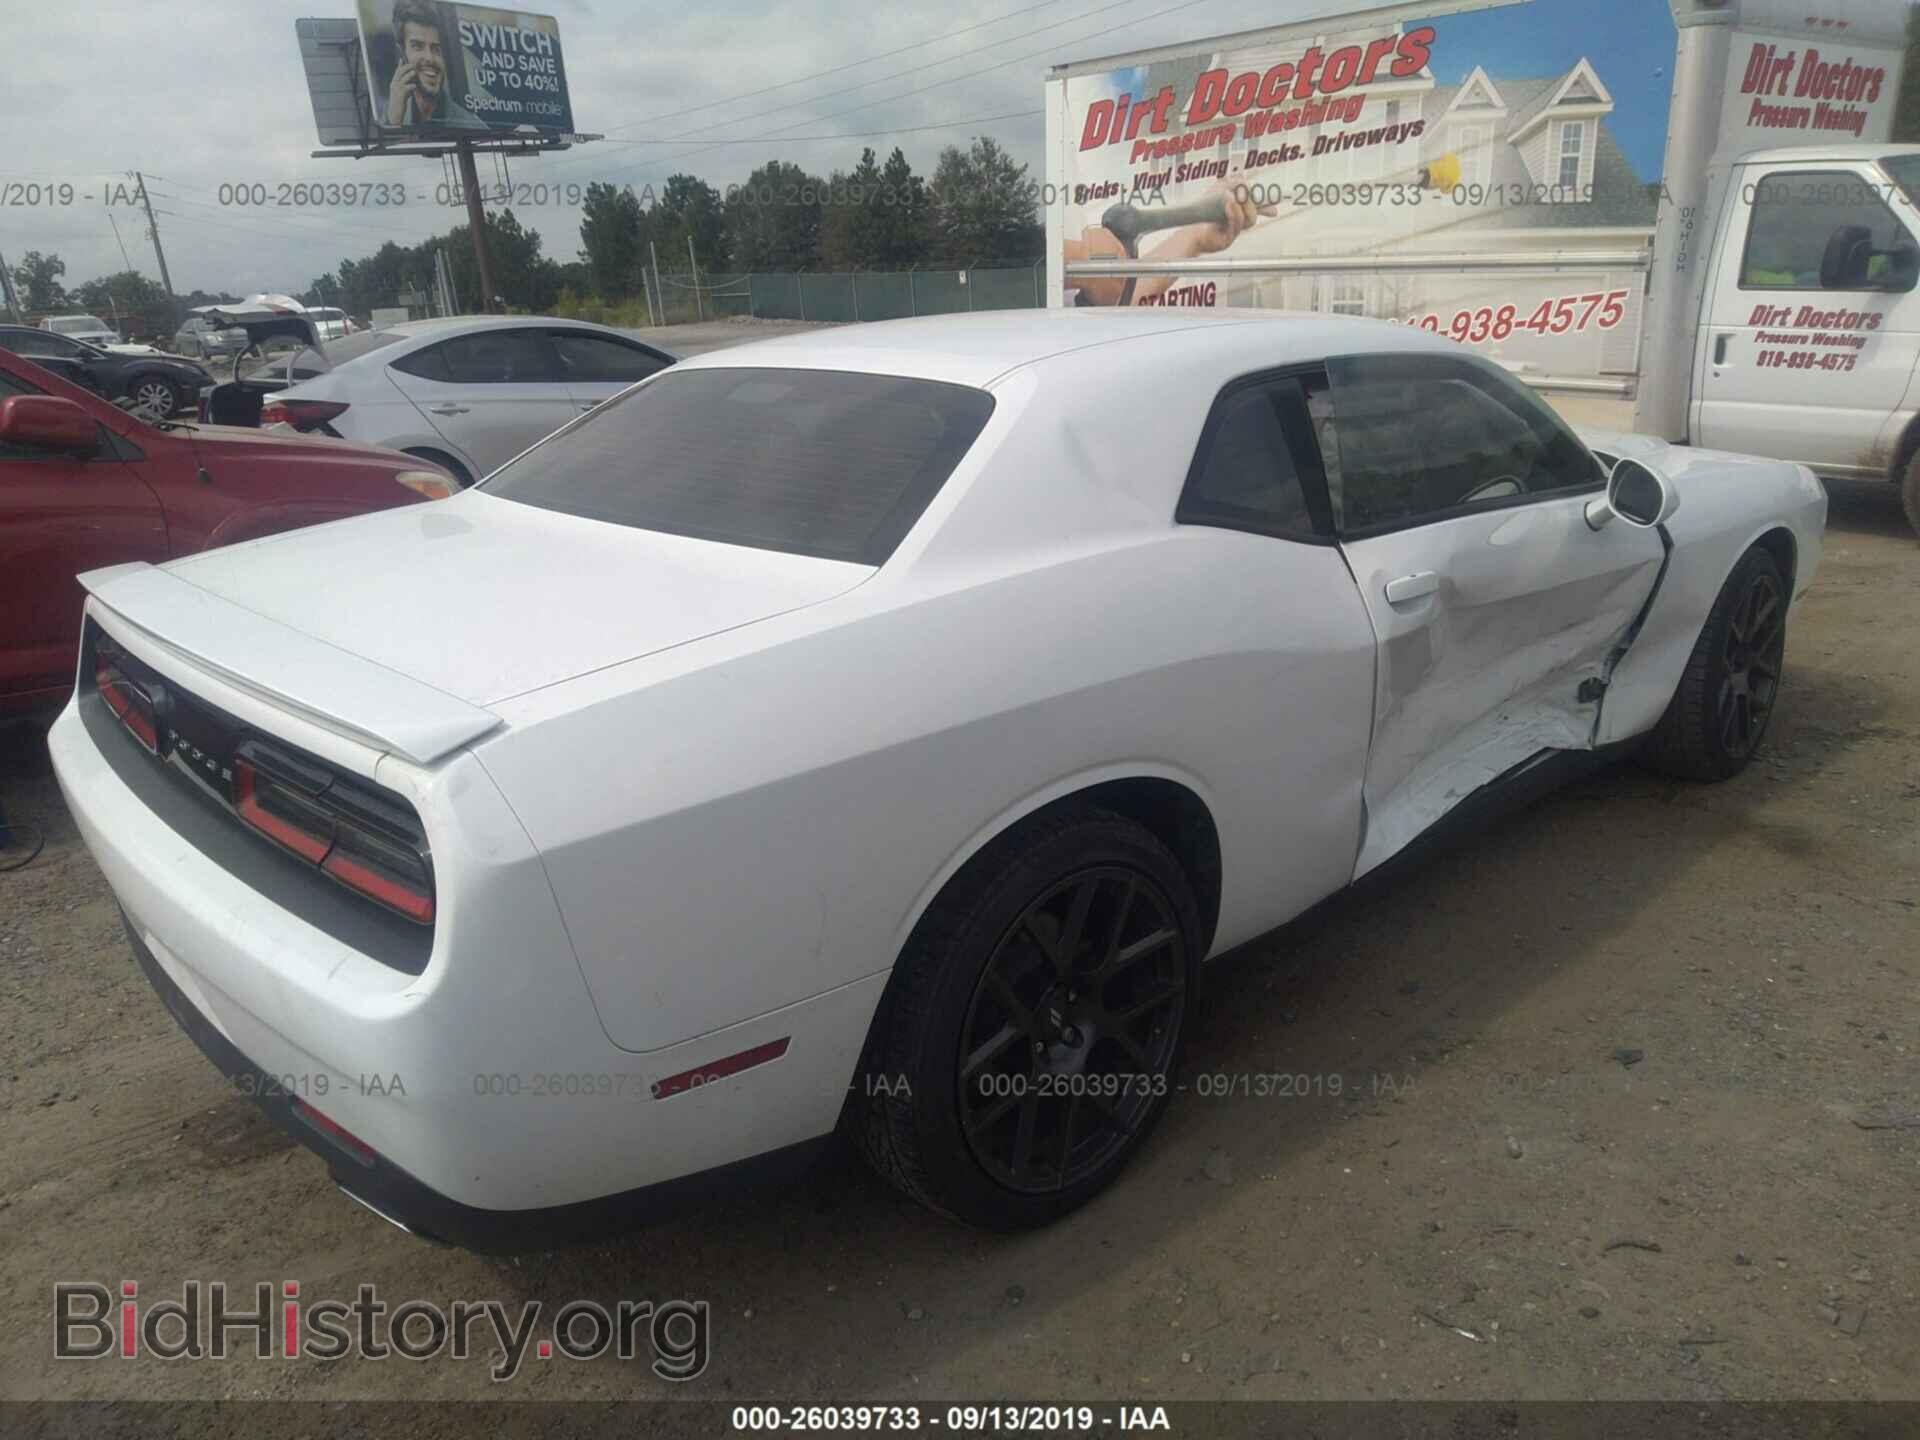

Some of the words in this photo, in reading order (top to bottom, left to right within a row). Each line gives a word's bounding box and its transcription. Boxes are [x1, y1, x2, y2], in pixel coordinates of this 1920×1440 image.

[458, 21, 553, 56] SWITCH
[481, 51, 515, 70] AND
[518, 55, 557, 75] SAVE
[1740, 42, 1795, 96] Dirt
[1794, 49, 1885, 103] Doctors
[474, 67, 496, 86] UP
[499, 71, 521, 89] TO
[524, 74, 560, 92] 40%!
[1079, 85, 1175, 152] Dirt
[1186, 26, 1435, 126] Doctors
[463, 94, 522, 113] Spectrum
[525, 101, 562, 116] mobile
[1747, 97, 1811, 128] Pressure
[1129, 123, 1236, 165] Pressure
[1243, 93, 1367, 140] Washing
[1074, 180, 1119, 203] Bricks
[1132, 167, 1173, 193] Vinyl
[1175, 159, 1230, 183] Siding
[1311, 119, 1426, 157] Driveways
[1748, 304, 1791, 326] Dirt
[1793, 305, 1883, 330] Doctors
[1754, 330, 1809, 345] Pressure
